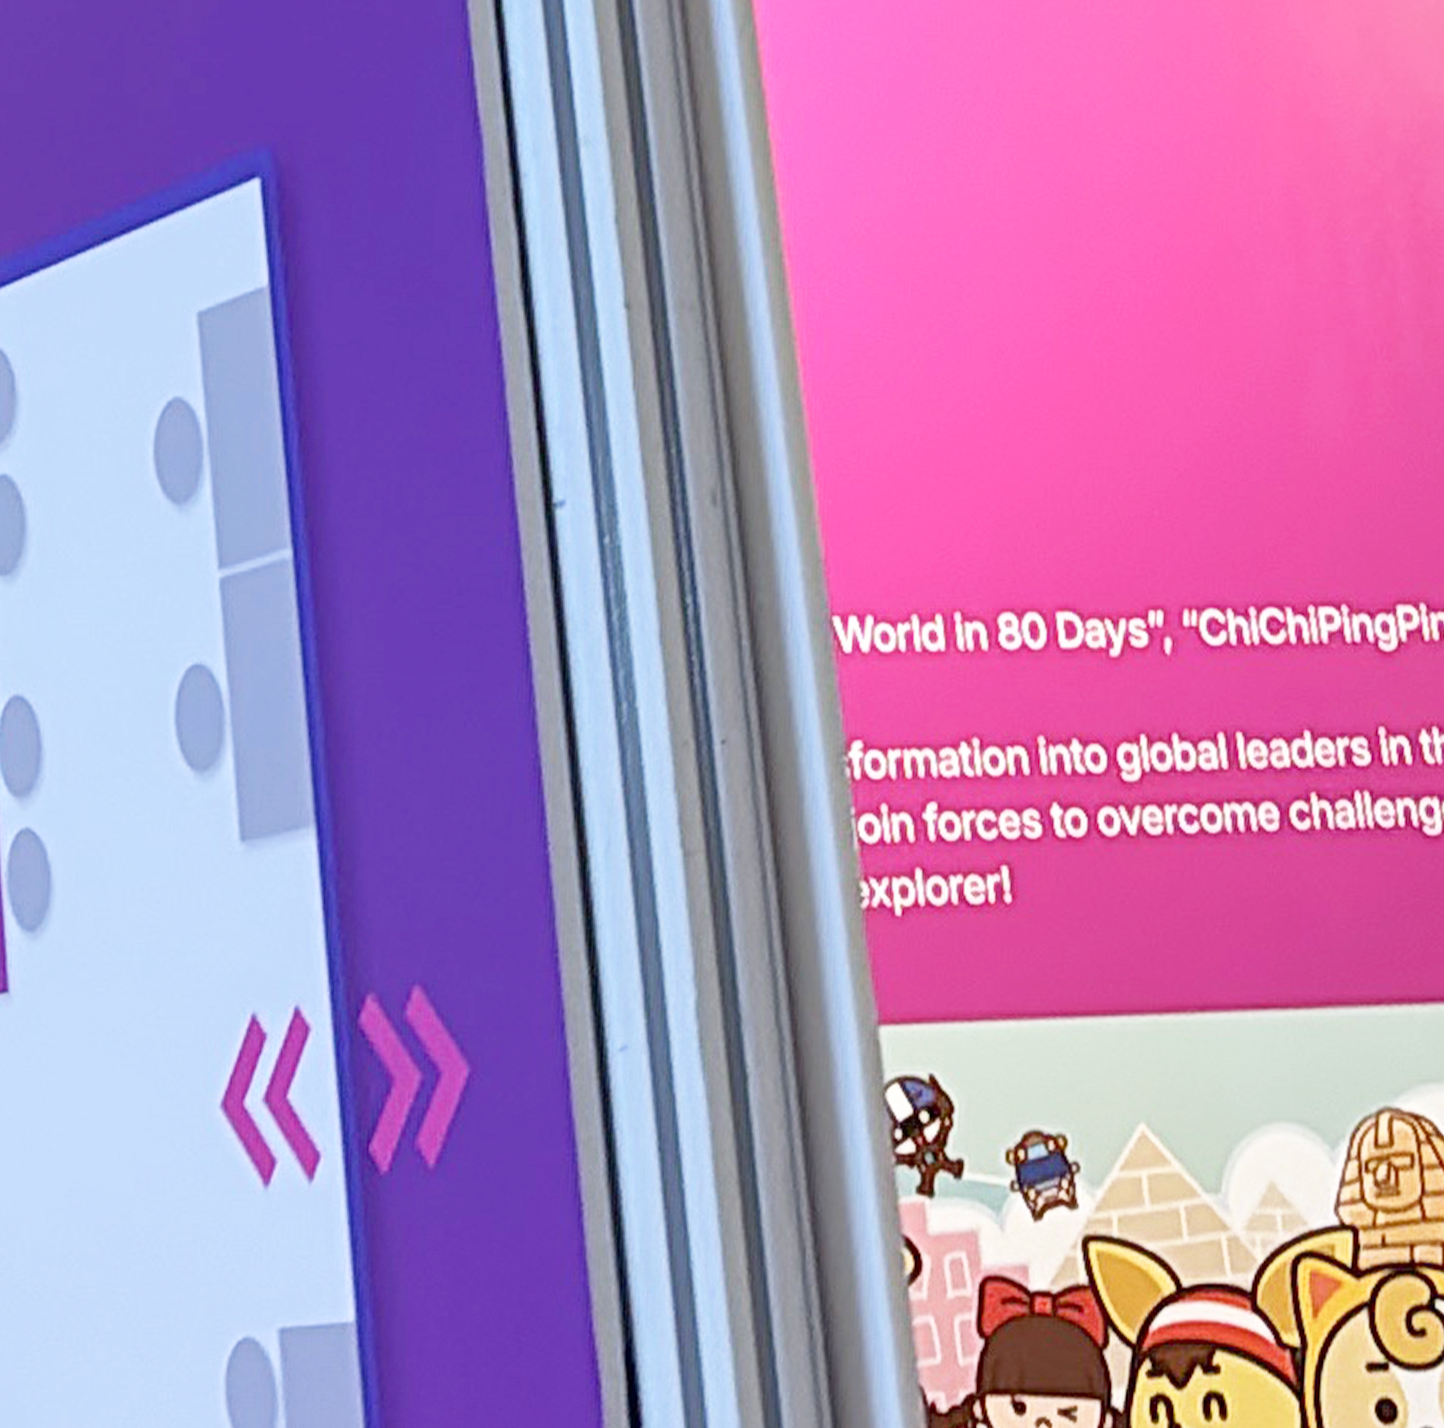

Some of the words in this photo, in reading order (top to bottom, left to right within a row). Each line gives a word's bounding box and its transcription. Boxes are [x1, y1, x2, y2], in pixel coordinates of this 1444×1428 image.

[831, 611, 946, 654] World
[953, 610, 989, 652] in
[997, 610, 1048, 651] 80
[844, 737, 1031, 780] formation
[1037, 735, 1108, 776] into
[1116, 732, 1229, 782] global
[1235, 729, 1372, 770] leaders
[1377, 726, 1413, 766] in
[921, 801, 1043, 842] forces
[1049, 801, 1089, 838] to
[1097, 801, 1280, 837] overcome
[1289, 790, 1444, 836] challeng
